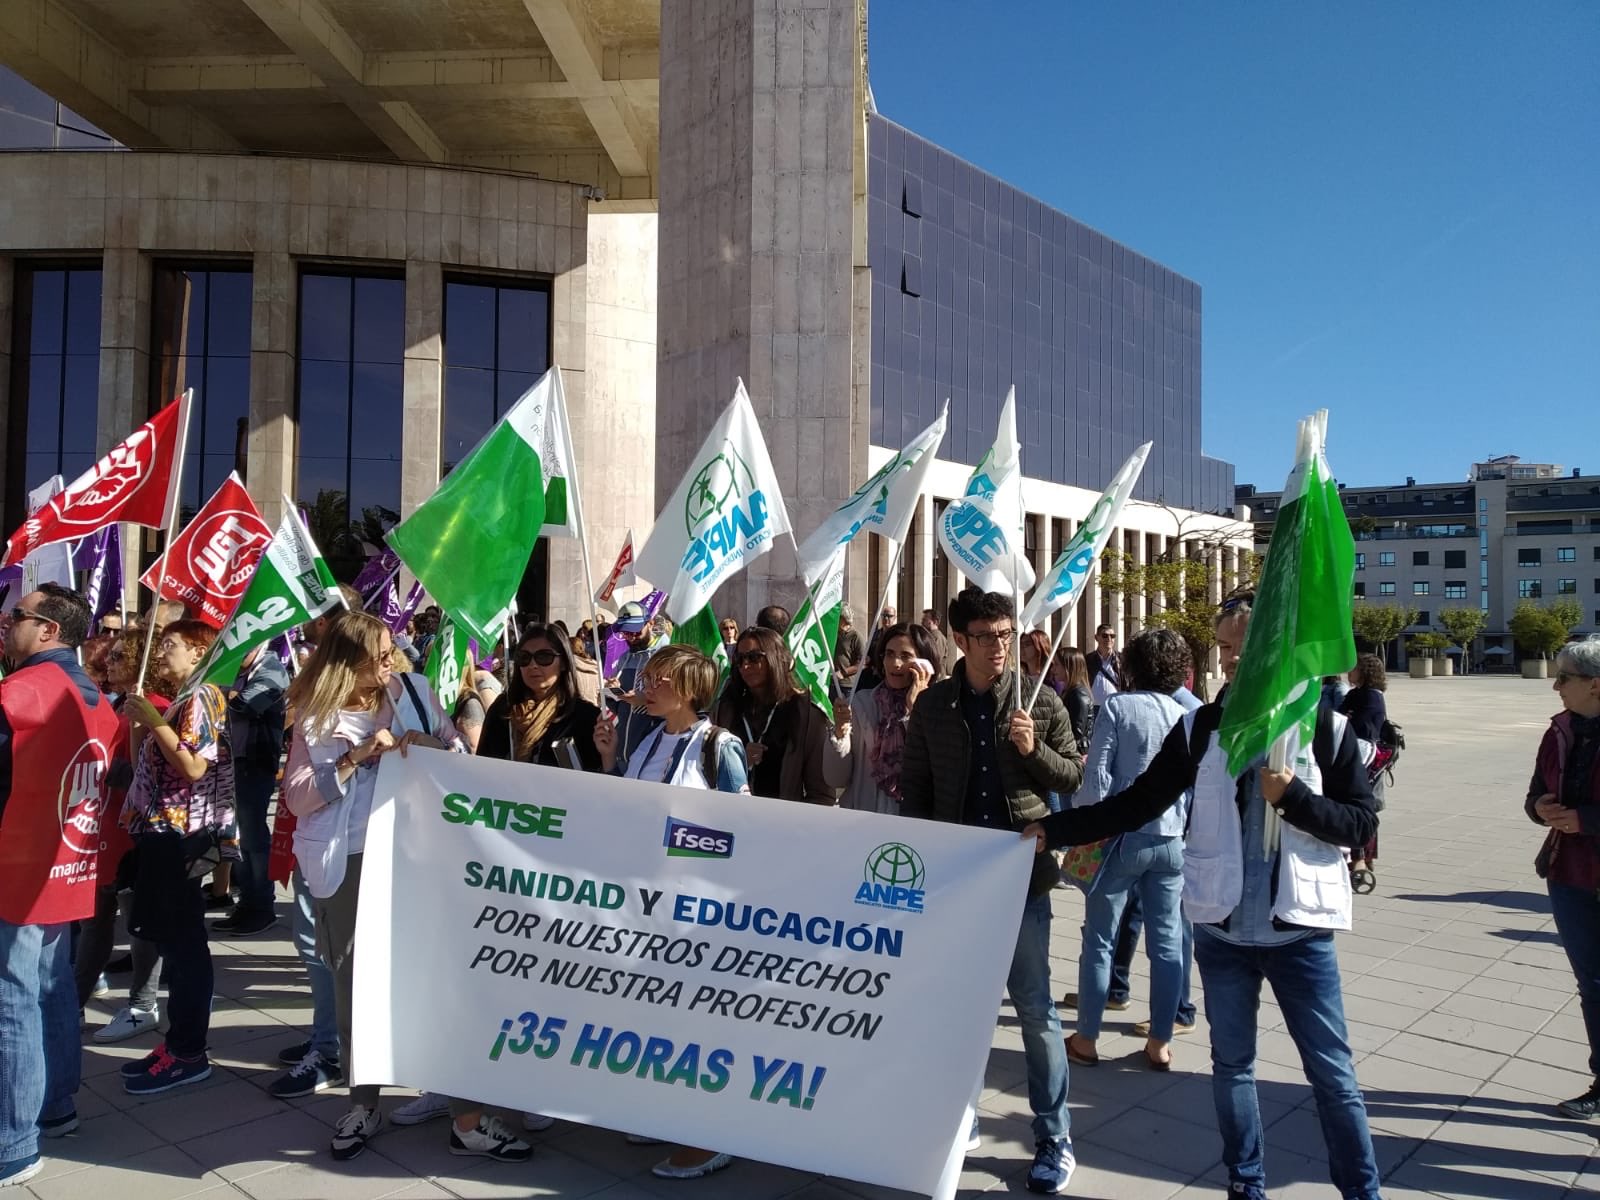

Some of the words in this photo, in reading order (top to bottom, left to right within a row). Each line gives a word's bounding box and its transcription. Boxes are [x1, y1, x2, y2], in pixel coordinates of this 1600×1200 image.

[194, 515, 252, 583] UGT
[441, 793, 567, 839] SATSE
[673, 828, 729, 853] fses
[464, 861, 626, 910] SANIDAD
[639, 888, 663, 916] Y
[673, 895, 903, 957] EDUCACIÓN
[855, 882, 925, 909] ANPE
[473, 905, 541, 939] POR
[543, 918, 710, 968] NUESTROS
[711, 946, 890, 998] DERECHOS
[470, 945, 538, 979] POR
[540, 959, 684, 1008] NUESTRA
[688, 985, 882, 1041] PROFESIÓN
[570, 1023, 734, 1093] HORAS
[749, 1055, 826, 1111] YA!
